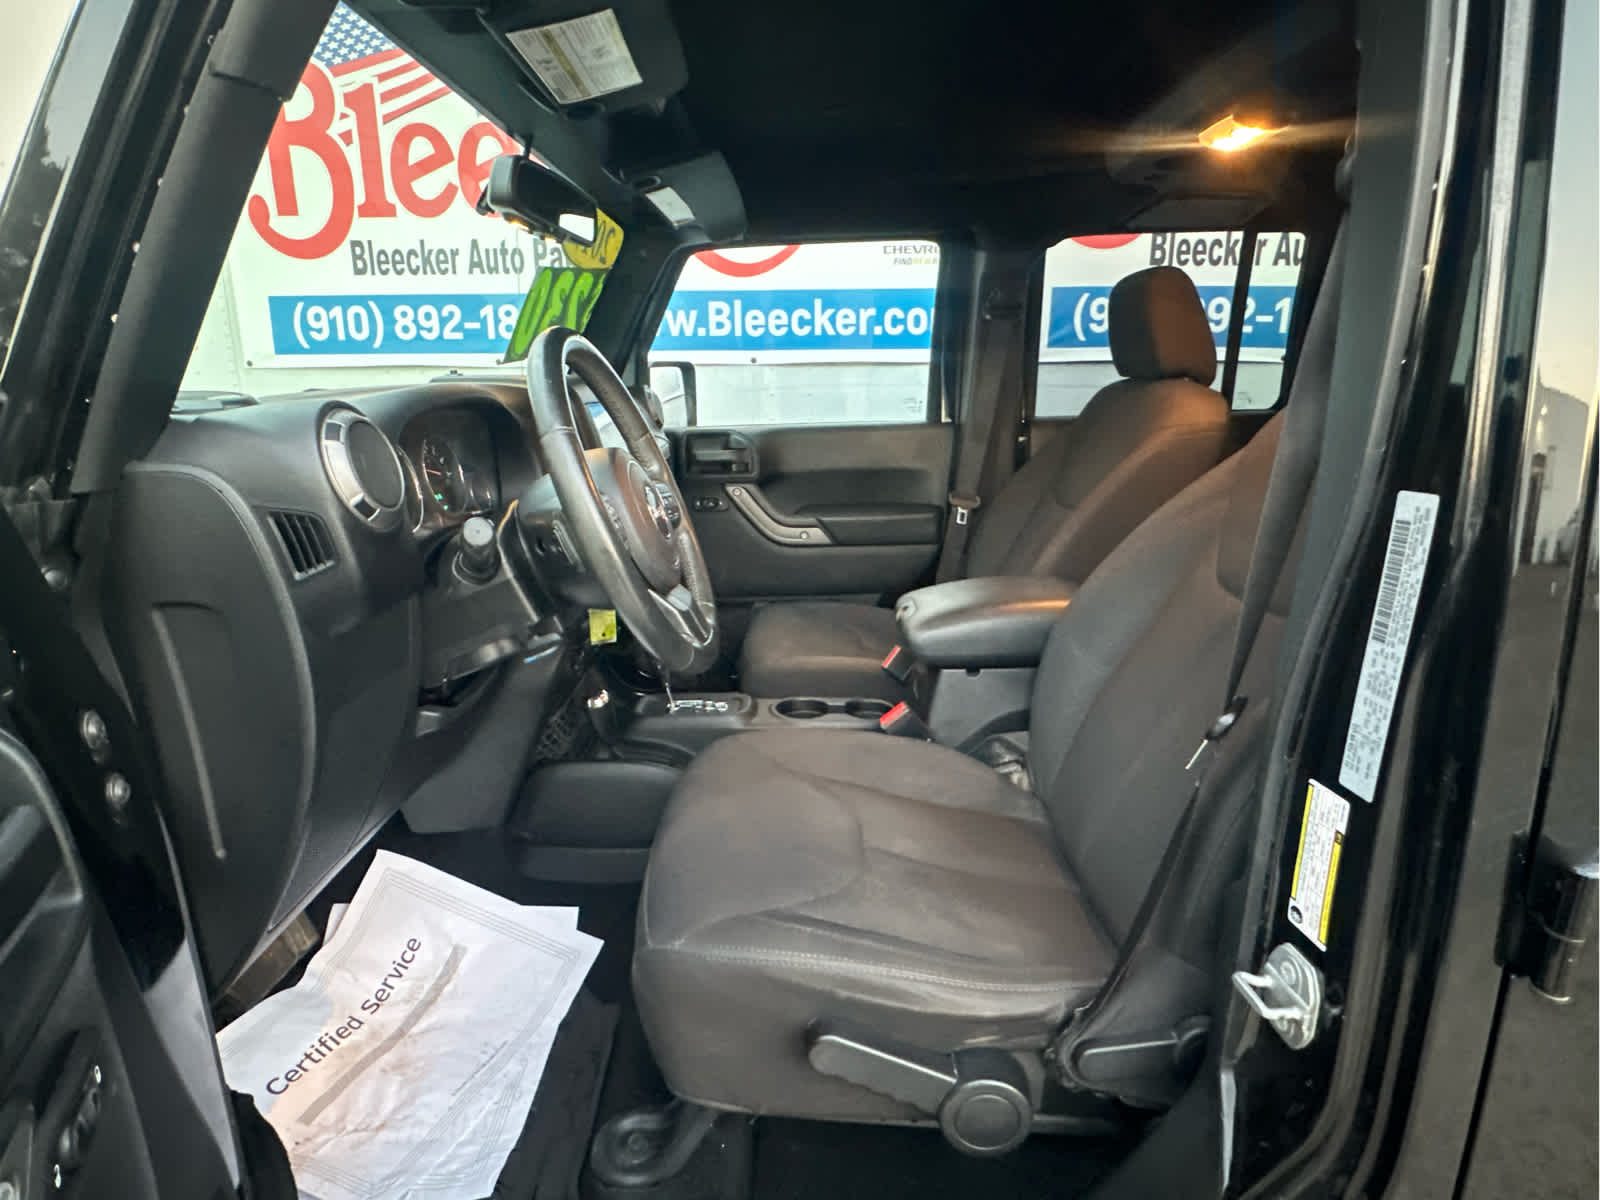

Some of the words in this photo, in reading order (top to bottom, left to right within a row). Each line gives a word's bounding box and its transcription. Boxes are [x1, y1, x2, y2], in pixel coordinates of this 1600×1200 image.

[248, 61, 523, 260] Blee
[350, 239, 459, 277] Bleecker
[468, 238, 525, 275] Auto
[1148, 231, 1268, 267] Bleeckr
[1272, 232, 1303, 267] Au
[293, 301, 384, 349] (910)
[393, 303, 518, 343] 892-18
[655, 298, 934, 338] w.Bleecker.co
[1201, 295, 1292, 335] 92-1
[266, 1015, 365, 1098] Certified
[361, 936, 422, 1017] Service
